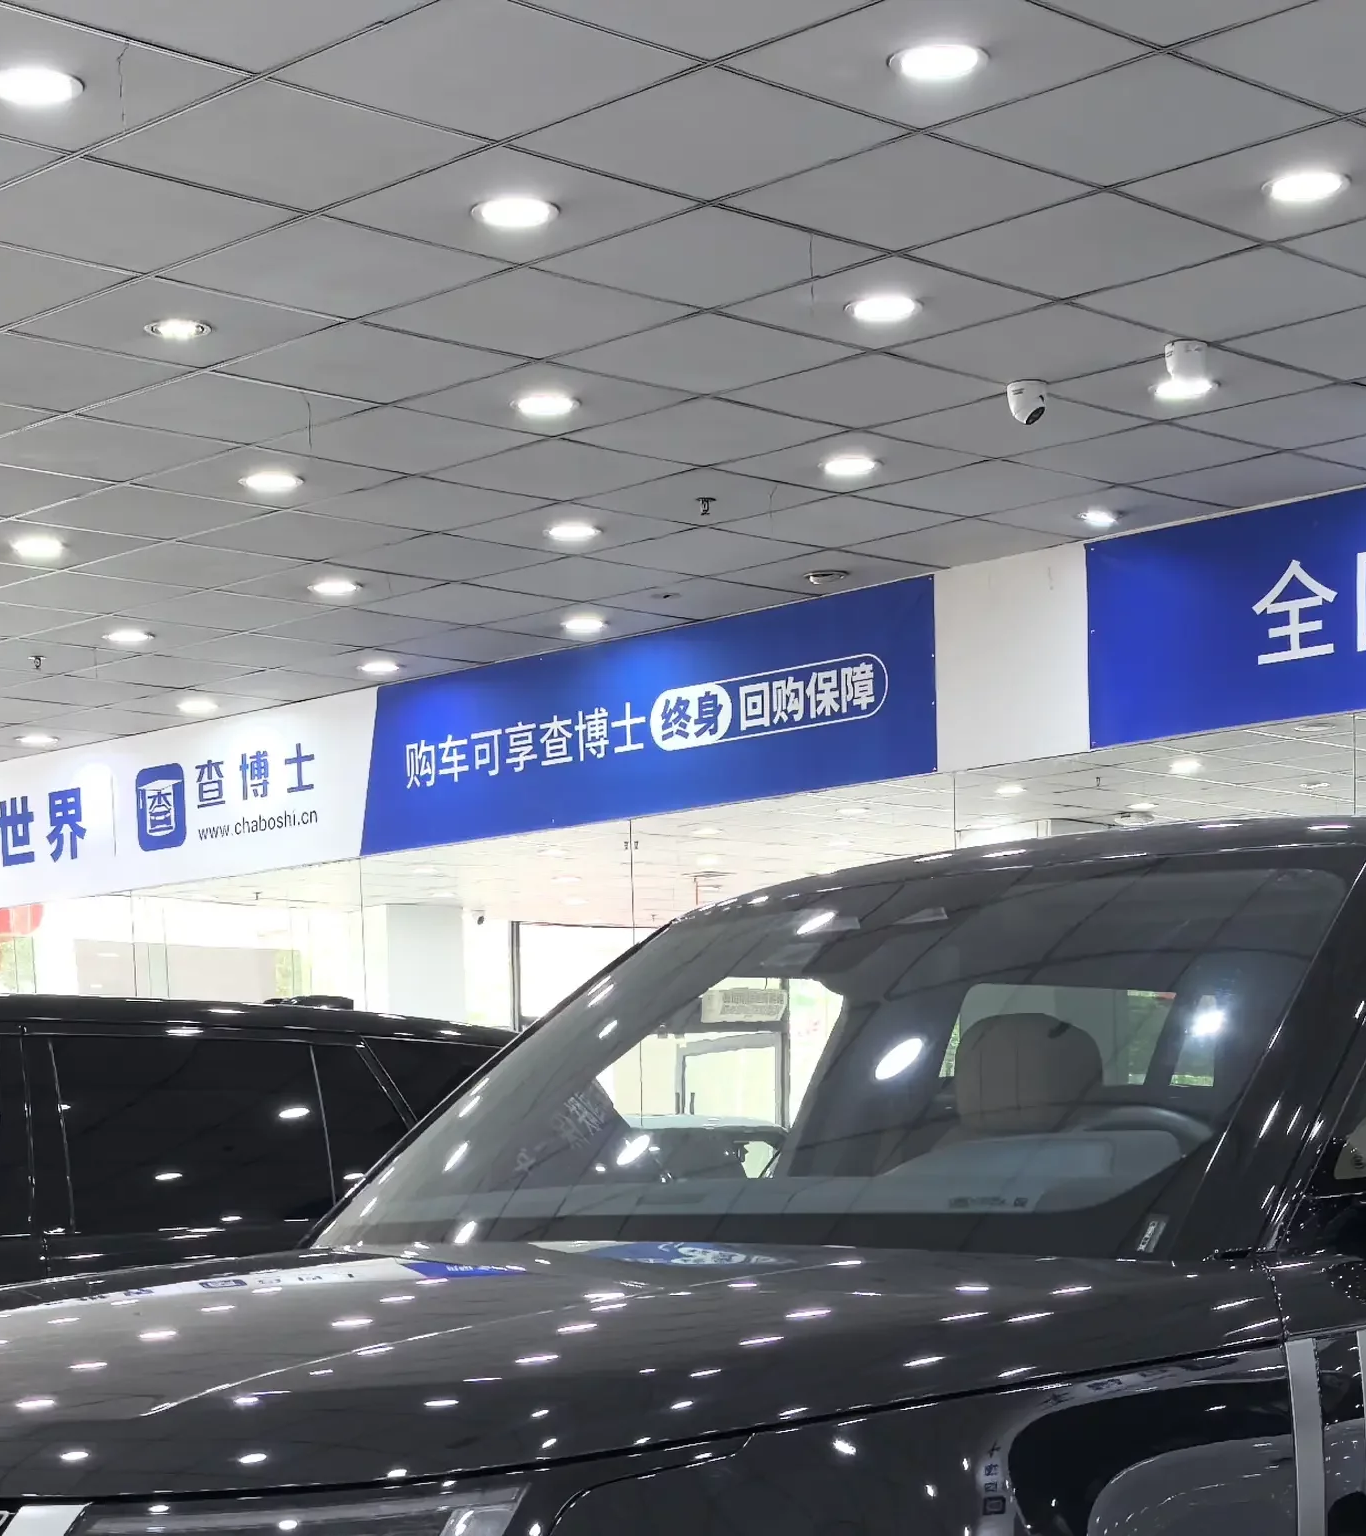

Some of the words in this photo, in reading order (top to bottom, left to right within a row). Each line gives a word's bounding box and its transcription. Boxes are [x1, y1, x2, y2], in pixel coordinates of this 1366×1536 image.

[405, 702, 646, 789] 购车可享查博士
[661, 691, 724, 741] 终身
[739, 662, 876, 731] 回购保障
[194, 742, 316, 809] 查博士
[197, 808, 319, 841] www.chaboshi.cn
